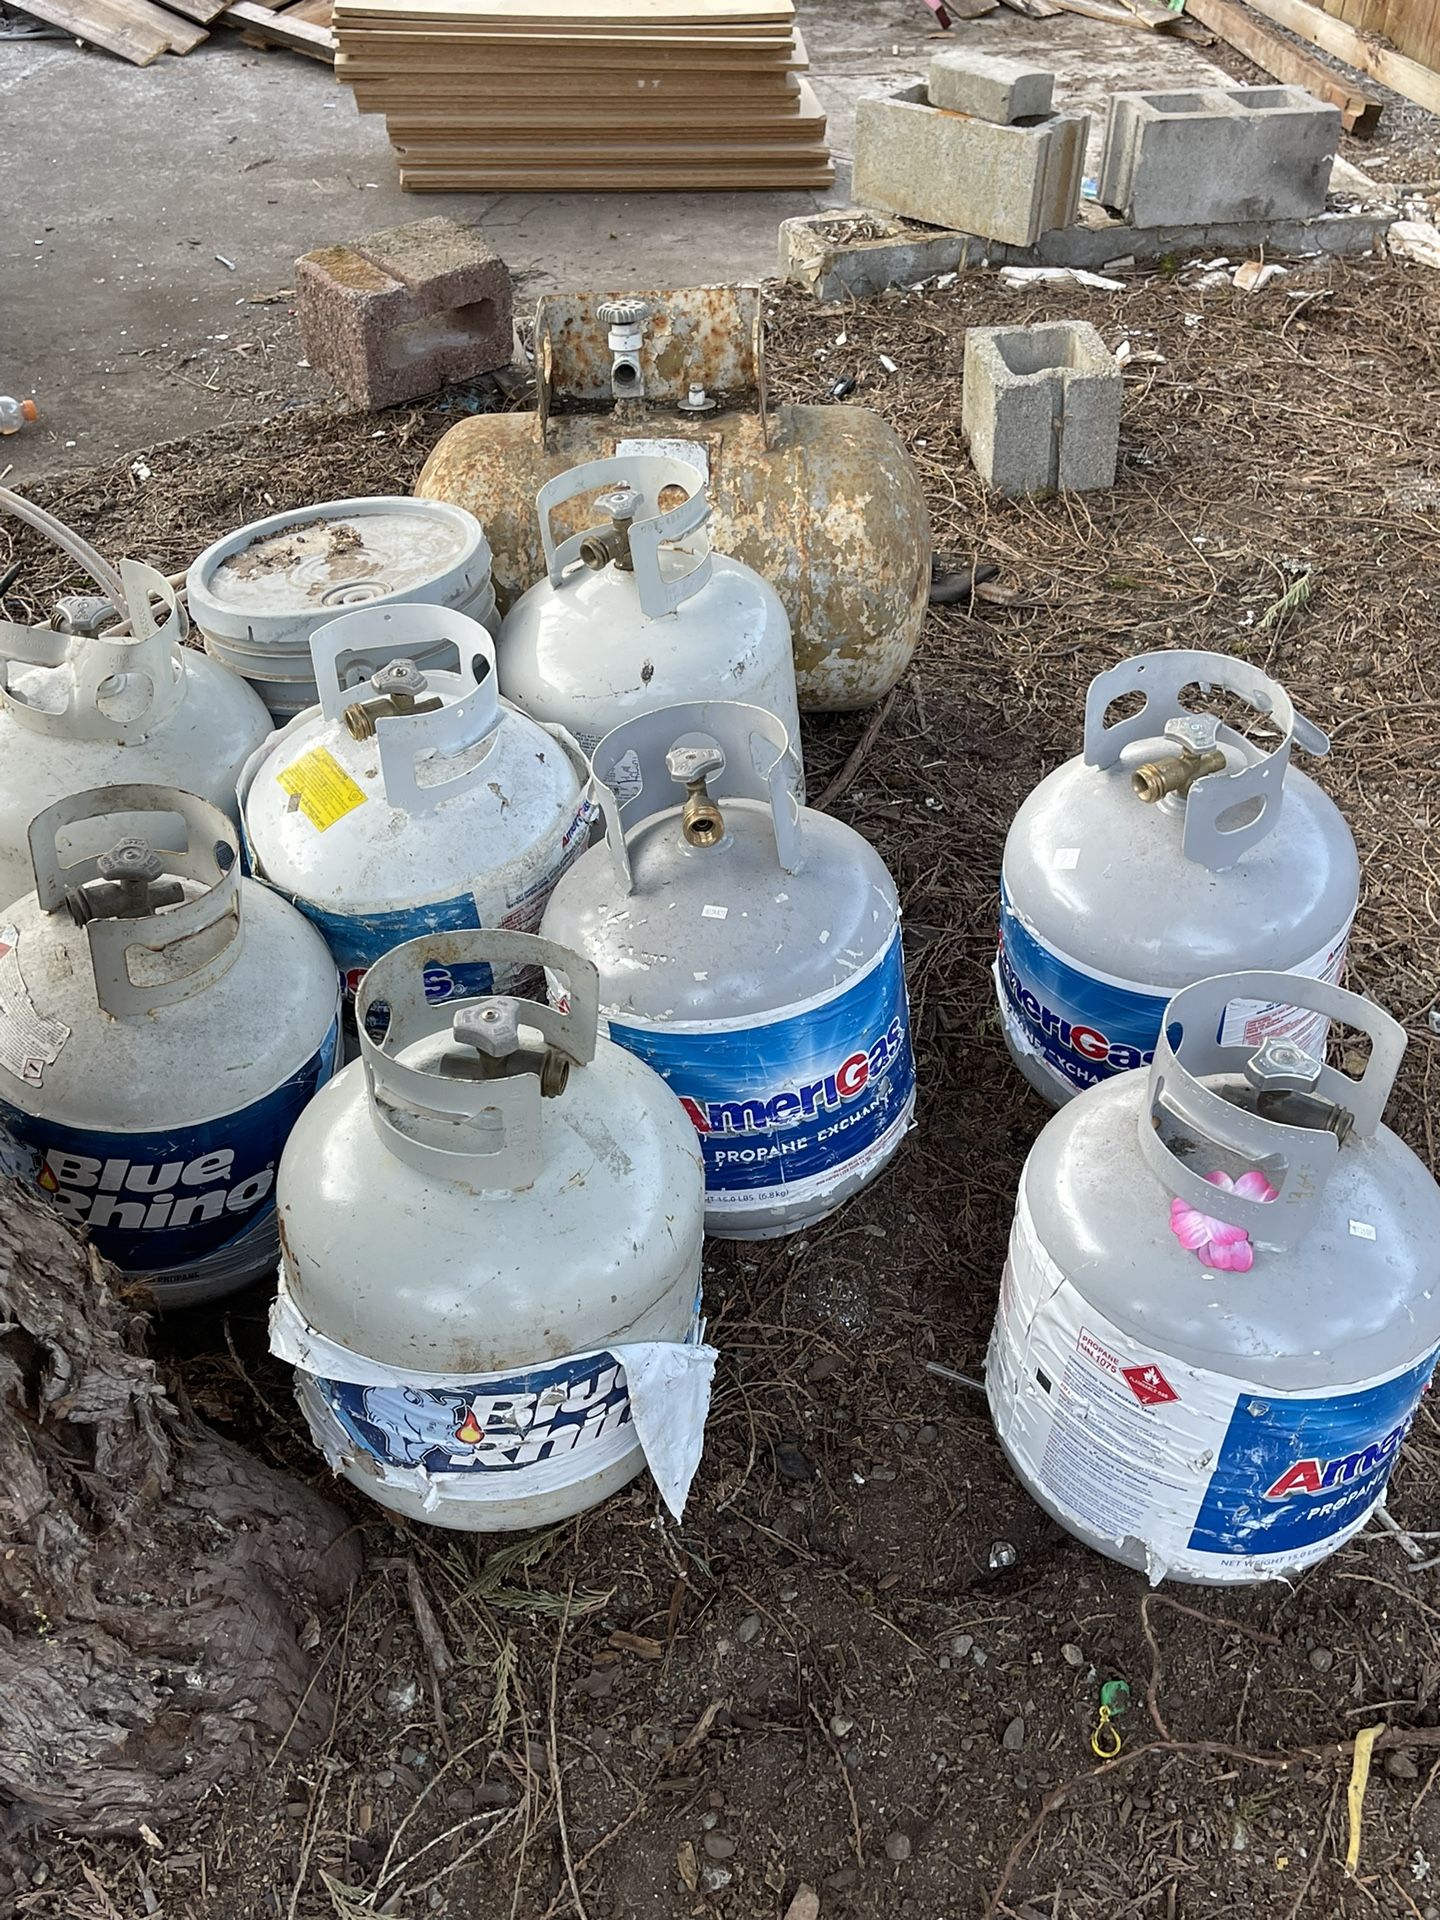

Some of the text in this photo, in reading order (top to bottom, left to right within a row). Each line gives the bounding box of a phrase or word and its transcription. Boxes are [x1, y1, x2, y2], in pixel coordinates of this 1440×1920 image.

[714, 1136, 808, 1164] PROPANE
[47, 1148, 235, 1193] Blue
[737, 1194, 755, 1202] LBS
[1082, 1335, 1120, 1366] PROPANE
[1095, 1354, 1118, 1374] 1075
[1220, 1559, 1241, 1567] NET
